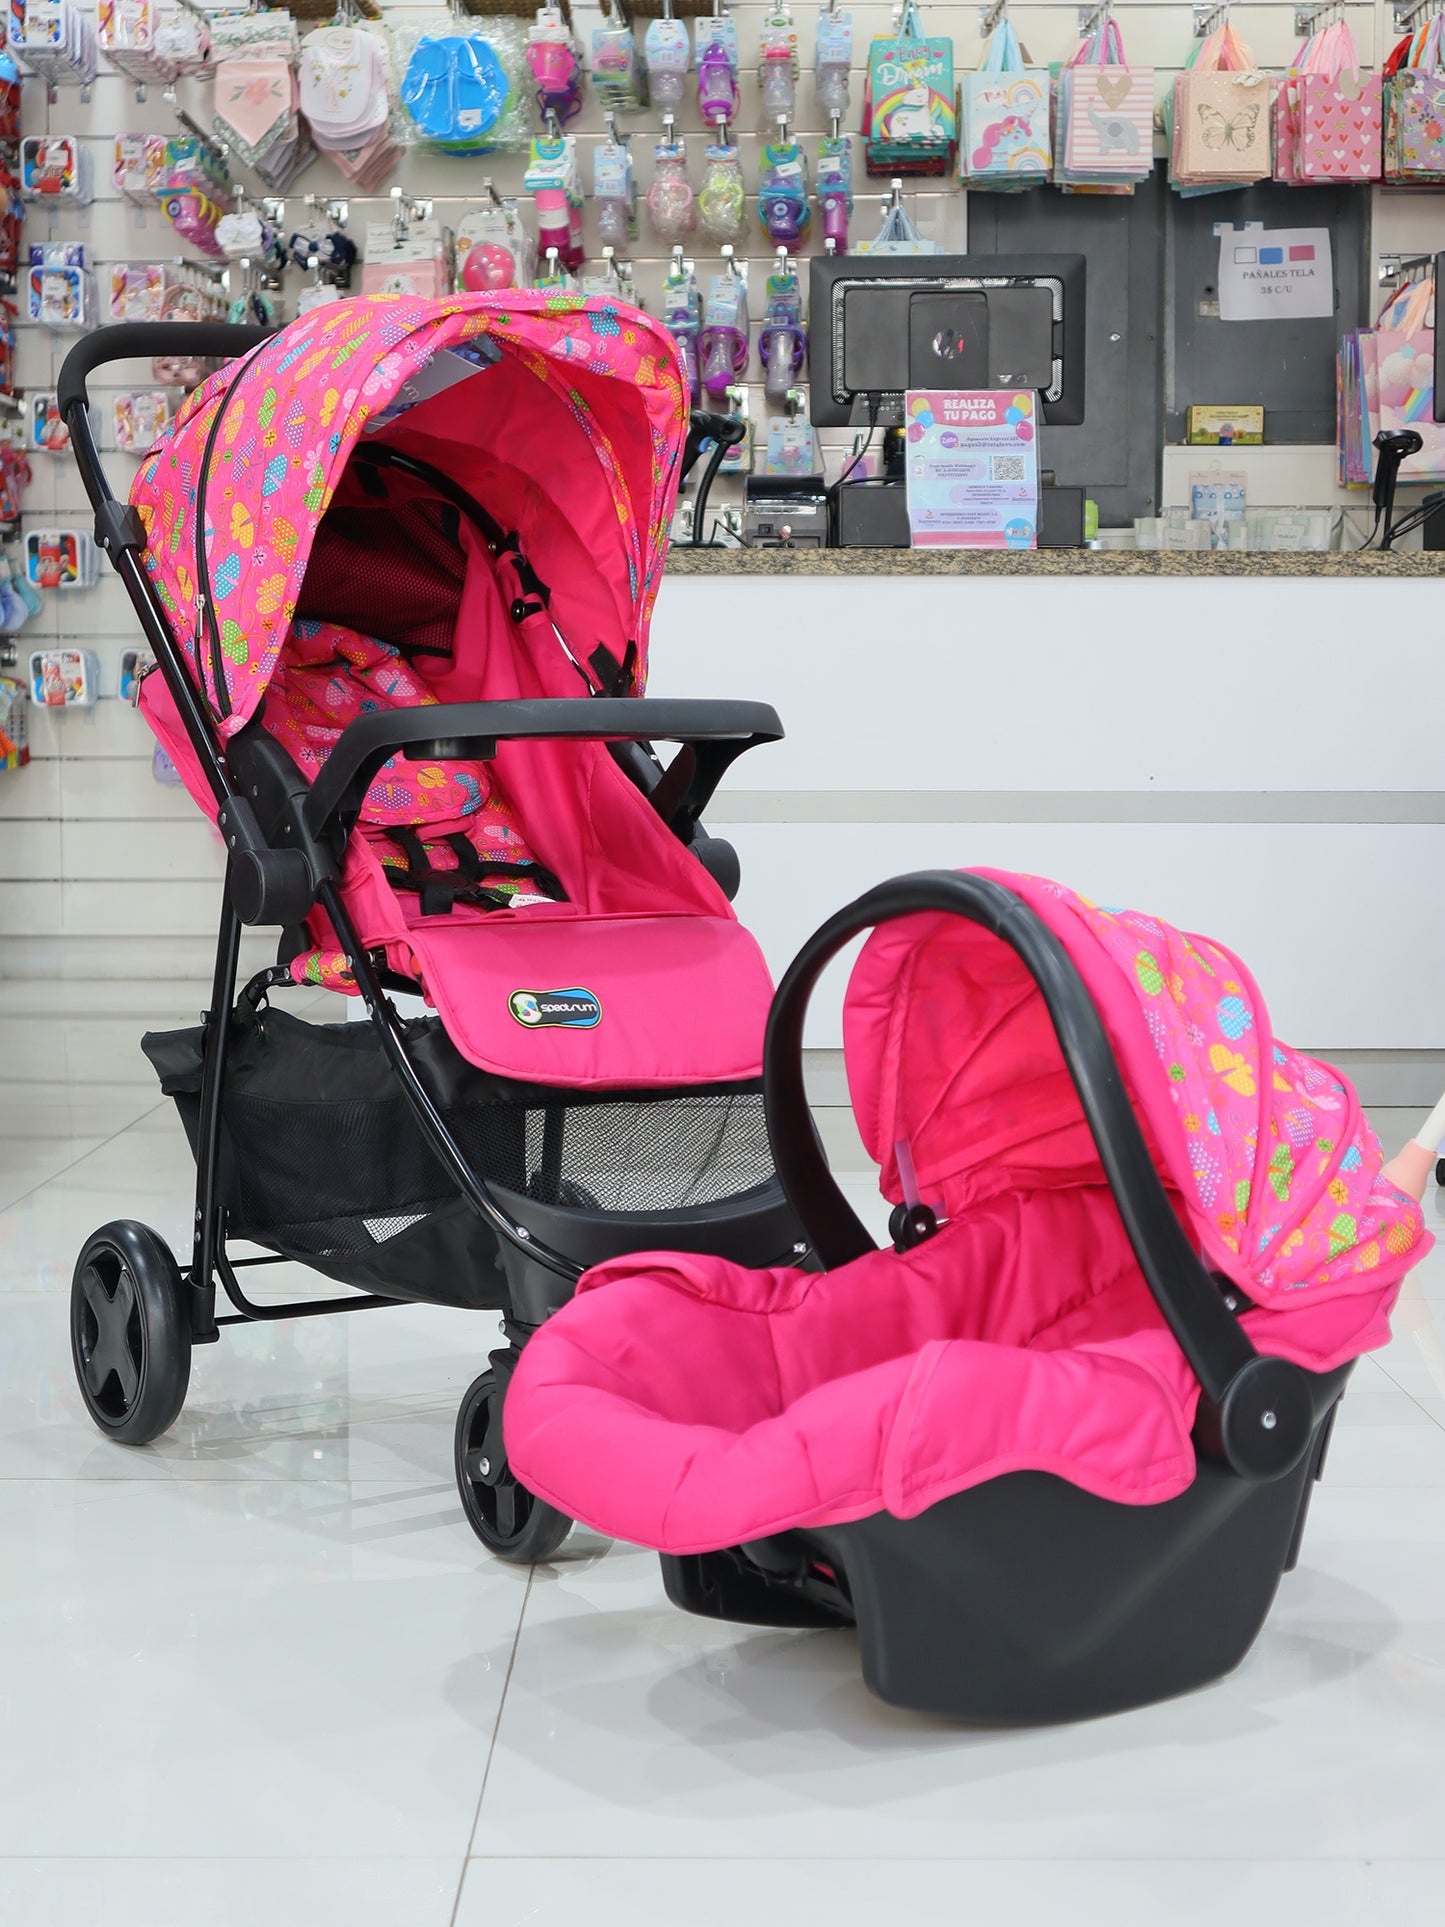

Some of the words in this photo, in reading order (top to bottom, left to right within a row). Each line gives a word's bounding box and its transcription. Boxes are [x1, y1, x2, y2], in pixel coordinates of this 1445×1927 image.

[877, 62, 943, 86] Dream
[1242, 269, 1288, 280] PAÑALES
[1289, 268, 1316, 278] TELA
[1275, 285, 1293, 294] C/U
[943, 399, 996, 410] REALIZA
[943, 410, 960, 421] TU
[962, 410, 997, 421] PAGO
[540, 1003, 597, 1012] spectrum
